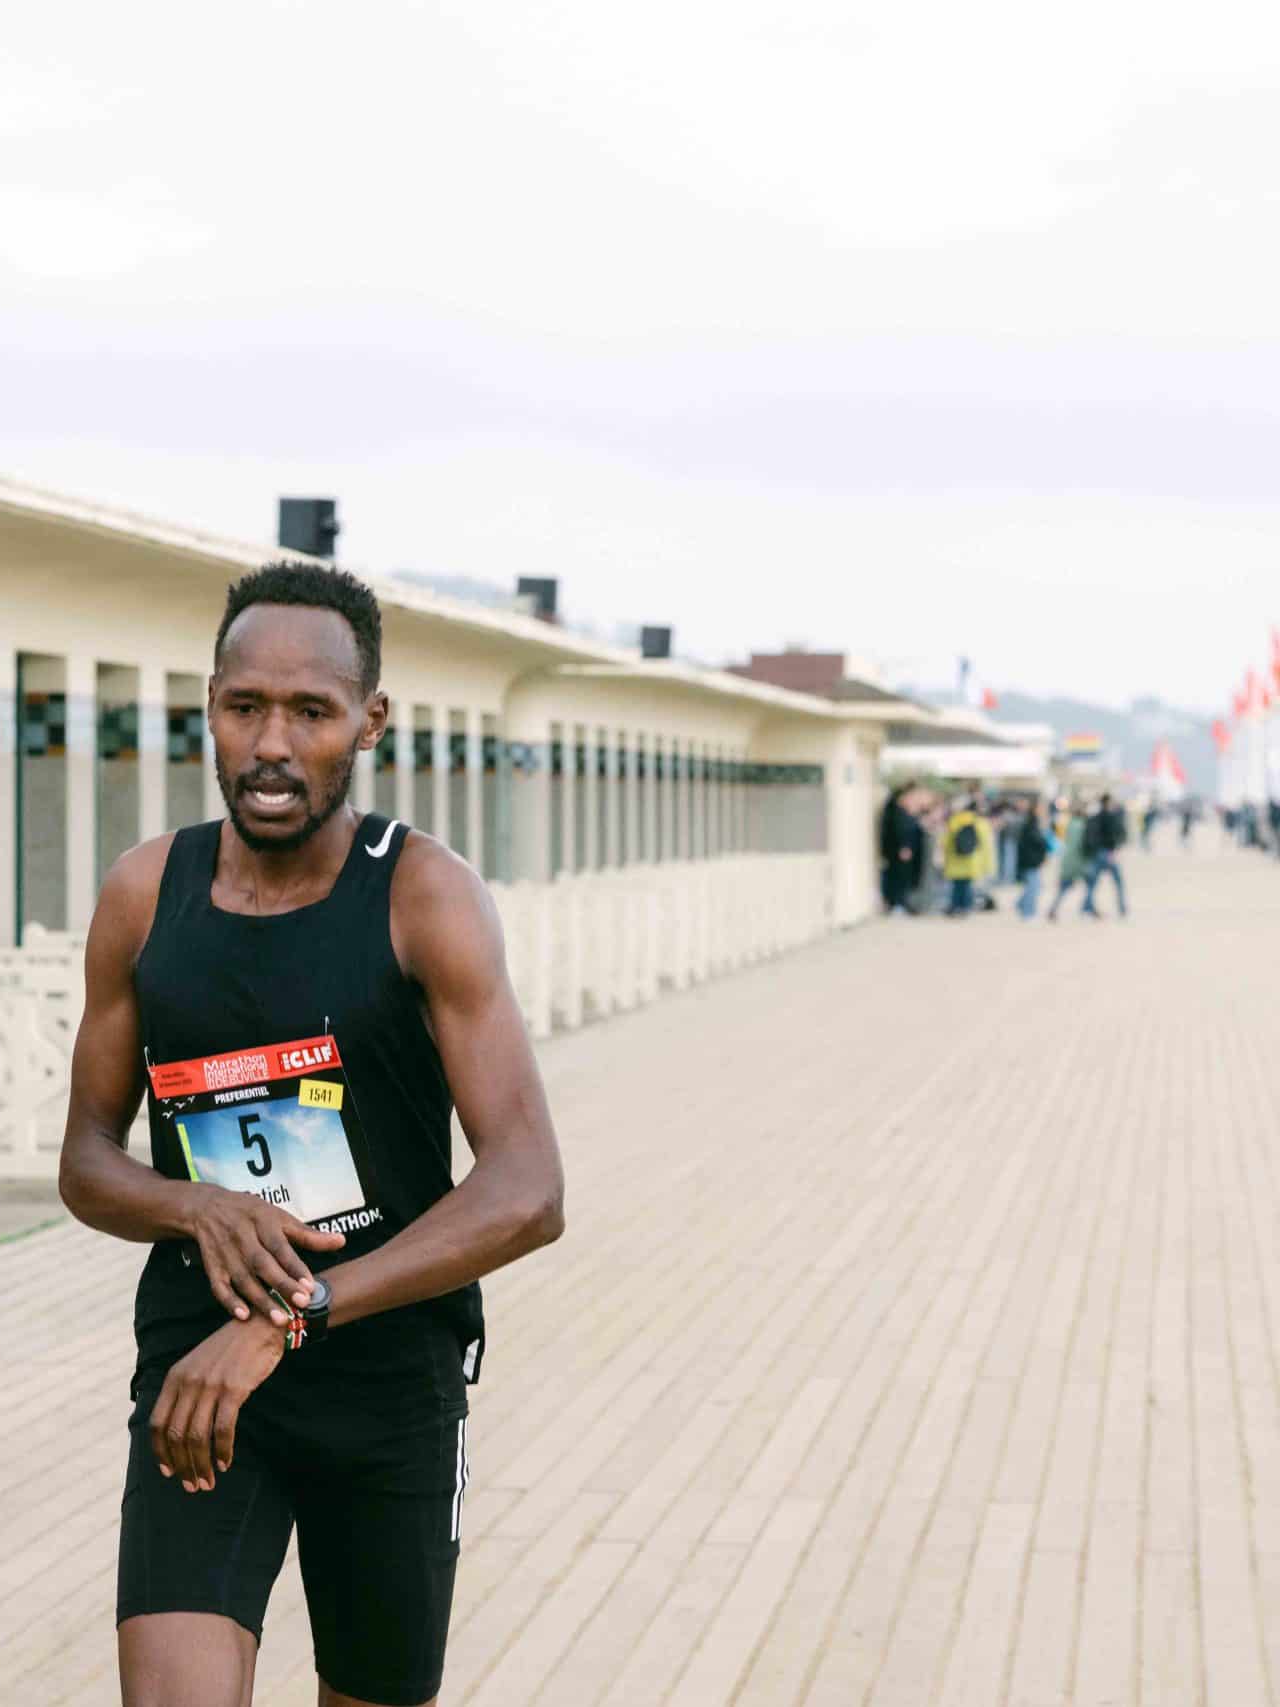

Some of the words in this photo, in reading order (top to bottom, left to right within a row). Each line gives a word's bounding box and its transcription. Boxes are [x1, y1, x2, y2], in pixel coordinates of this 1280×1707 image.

[215, 1086, 270, 1104] PREFERENTIEL
[310, 1088, 332, 1104] 1541
[238, 1113, 272, 1177] 5
